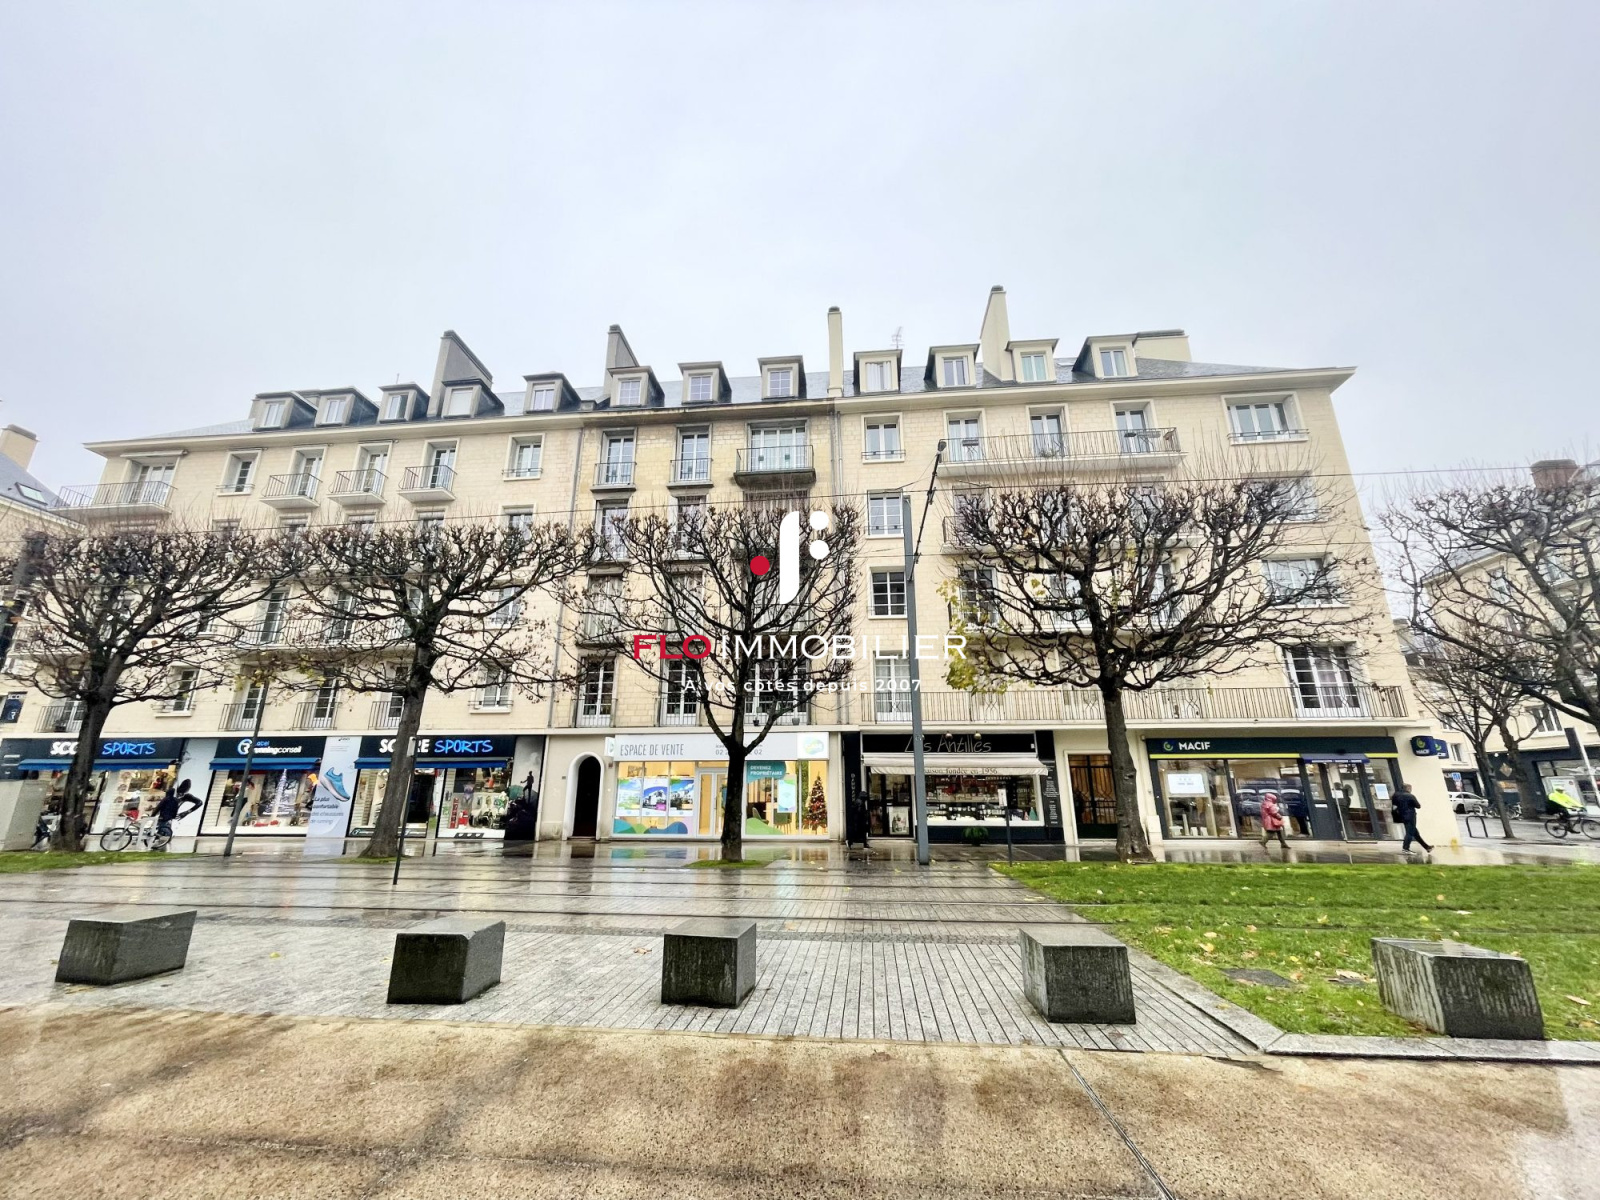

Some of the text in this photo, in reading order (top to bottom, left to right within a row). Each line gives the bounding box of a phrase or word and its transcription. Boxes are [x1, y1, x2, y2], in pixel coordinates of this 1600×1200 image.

[102, 741, 156, 756] SPORTS
[379, 739, 493, 754] SCE SPORTS
[620, 743, 684, 756] ESPACE DE VENTE
[904, 734, 992, 752] Ls Antilles
[1178, 741, 1211, 750] MACIF
